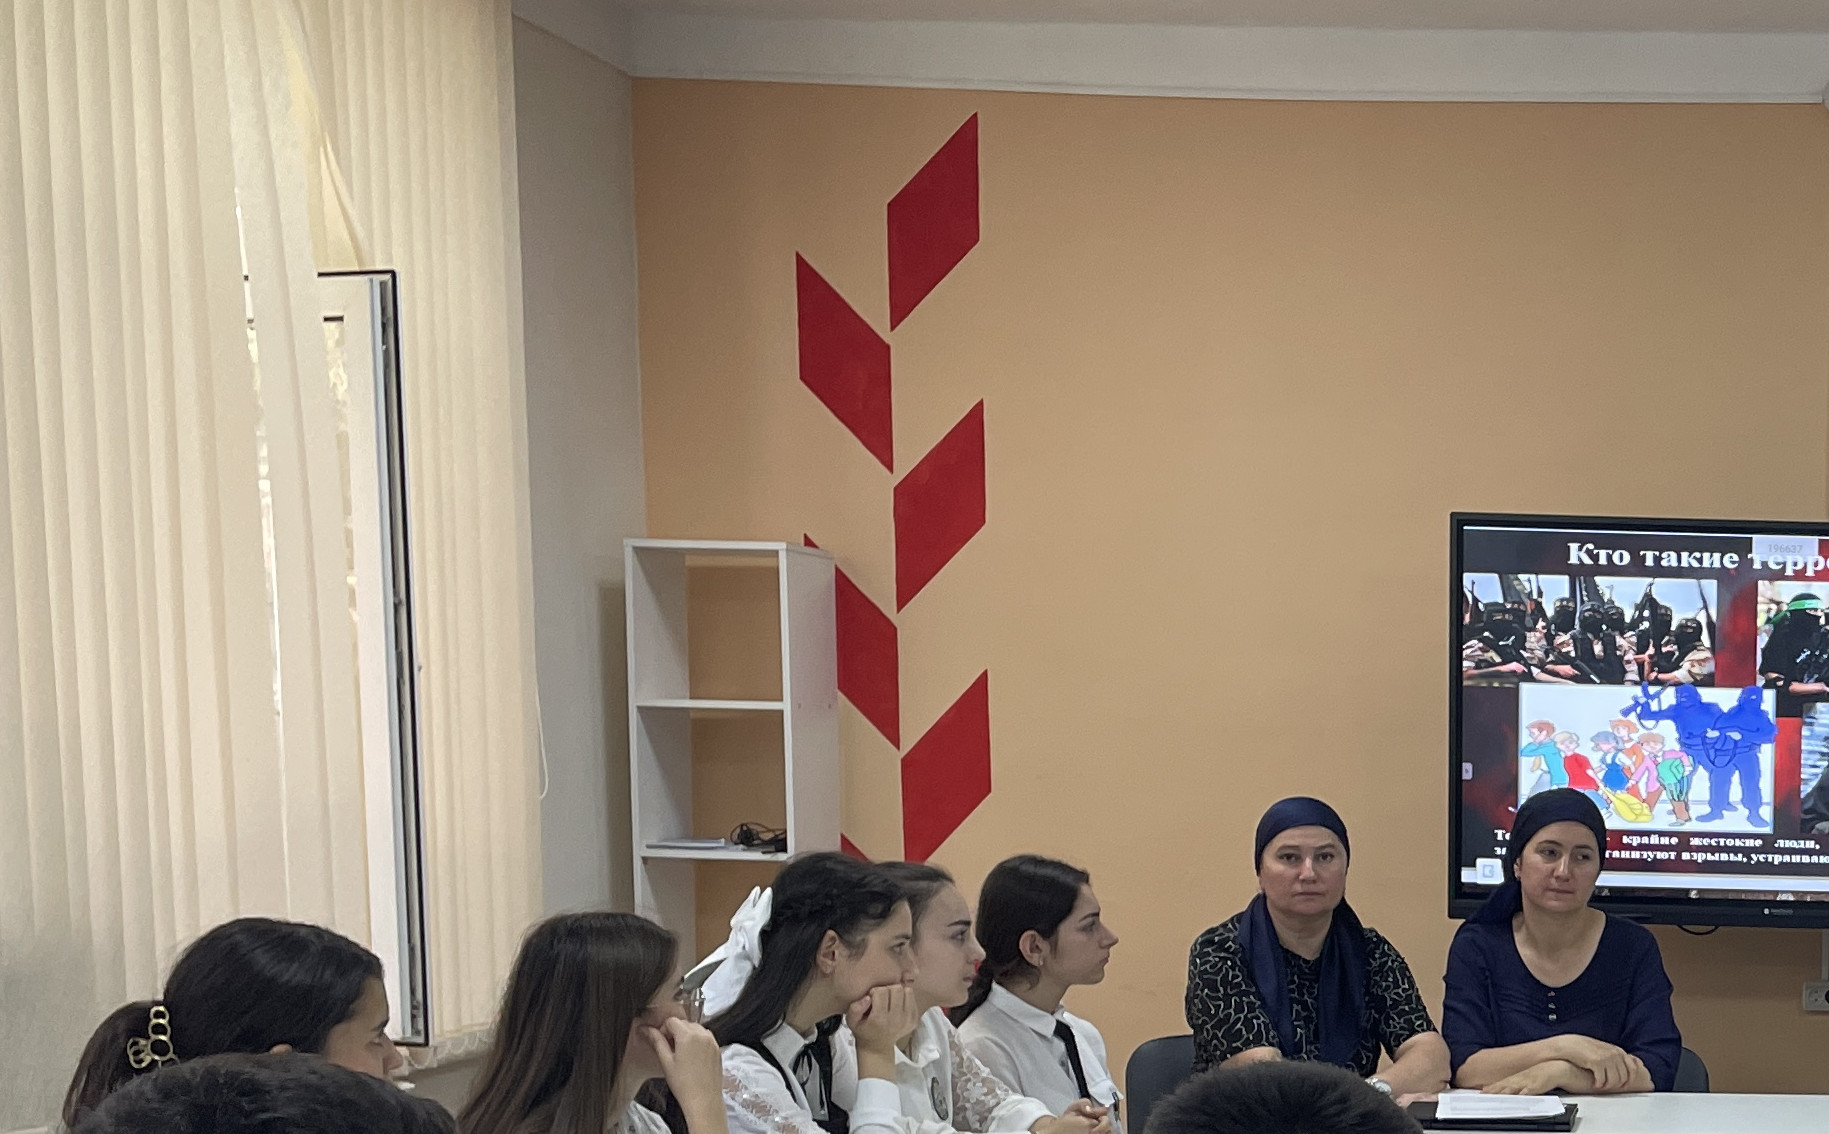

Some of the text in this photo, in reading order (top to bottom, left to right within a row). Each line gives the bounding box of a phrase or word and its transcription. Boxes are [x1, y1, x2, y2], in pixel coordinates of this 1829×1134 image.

[1566, 542, 1631, 566] Кто
[1639, 550, 1740, 569] такие
[1622, 833, 1679, 847] крайне
[1689, 837, 1763, 848] жестокие
[1773, 839, 1821, 851] люди,
[1604, 849, 1677, 862] ганизуют
[1681, 851, 1748, 864] взрывы,
